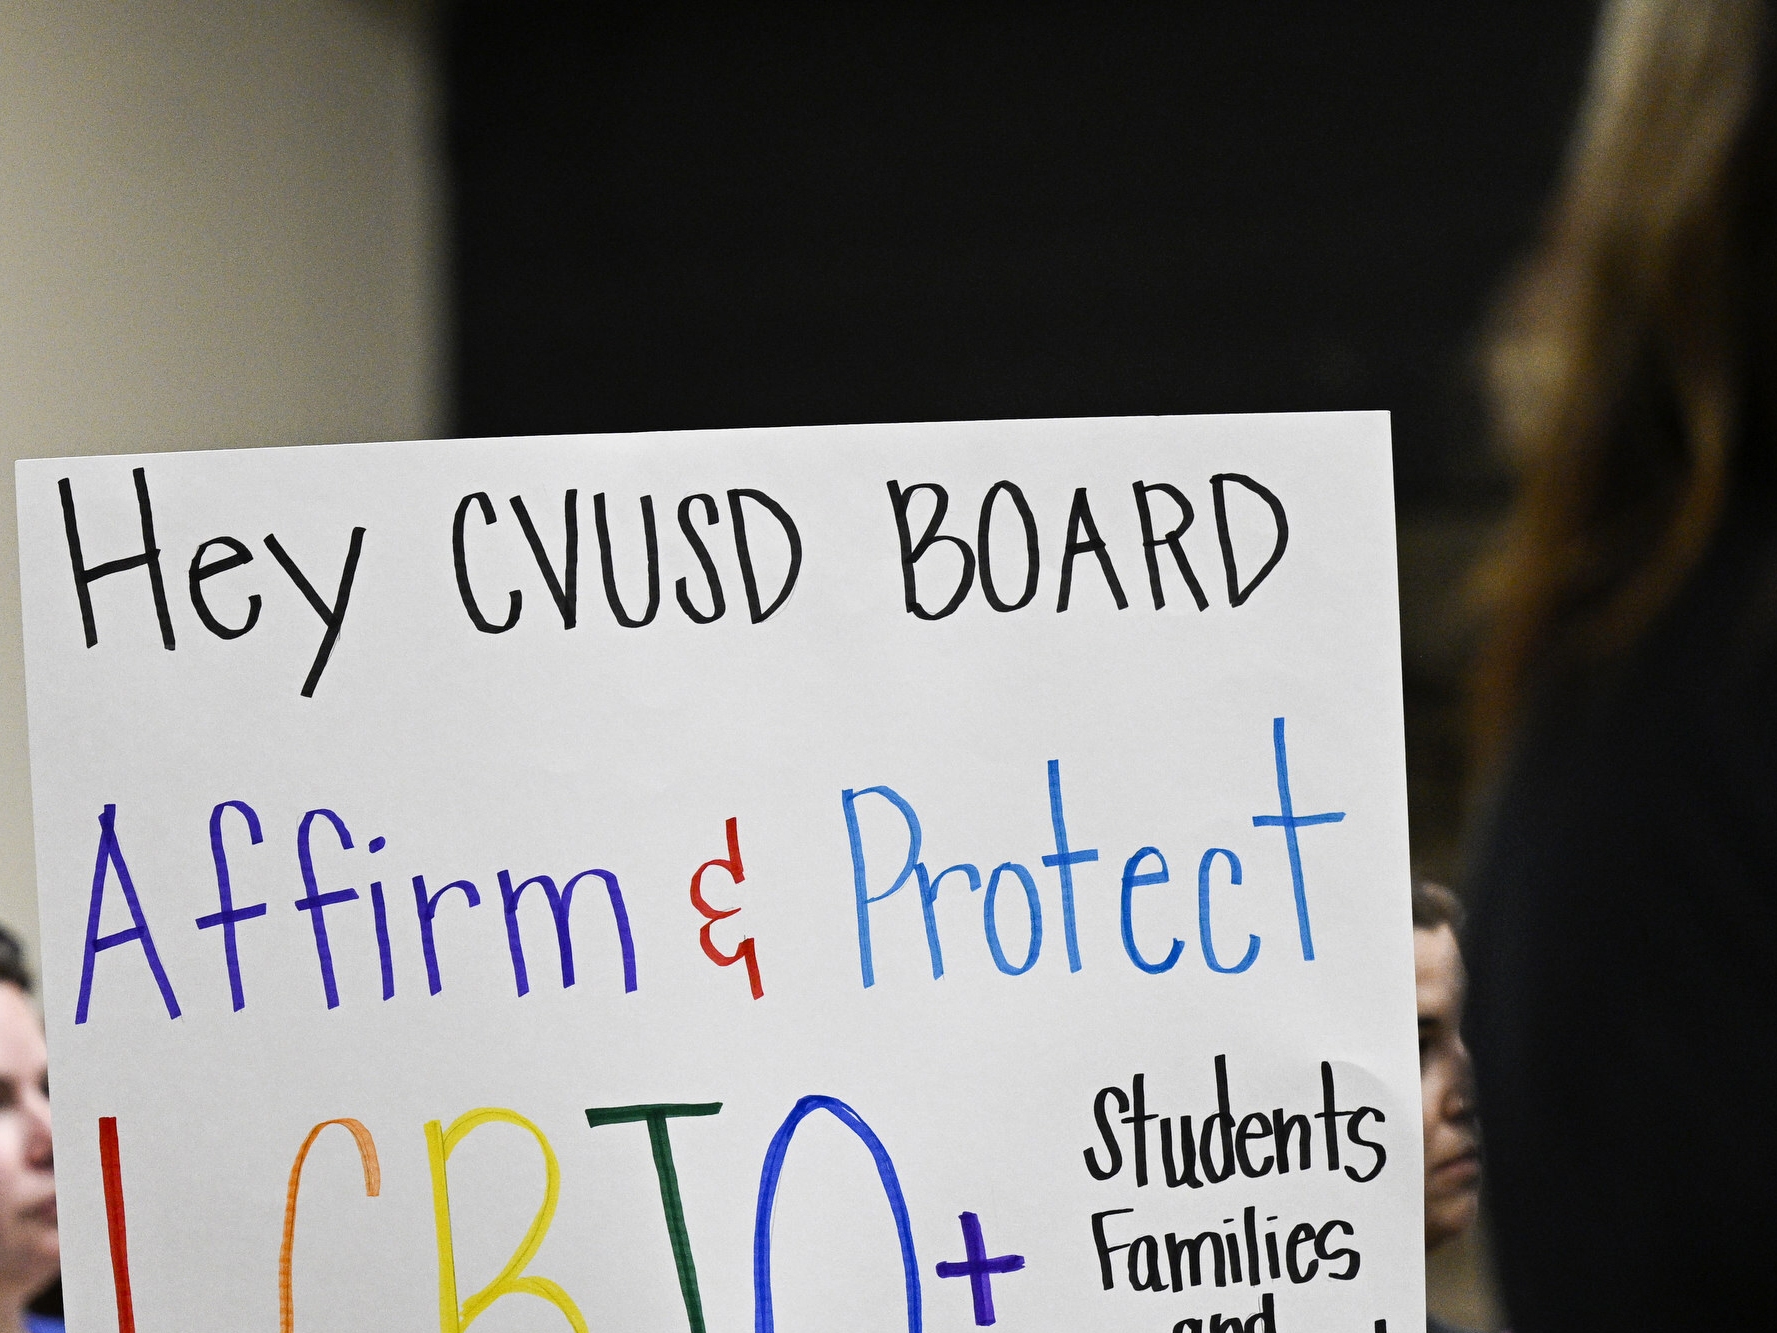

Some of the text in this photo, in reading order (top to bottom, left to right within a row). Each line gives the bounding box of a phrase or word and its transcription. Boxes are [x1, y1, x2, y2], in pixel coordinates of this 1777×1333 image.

[57, 467, 1289, 698] Hey CVUSD BOARD
[74, 716, 1347, 1025] Affirm & Protect
[1083, 1054, 1387, 1188] Students
[1090, 1206, 1362, 1292] Families
